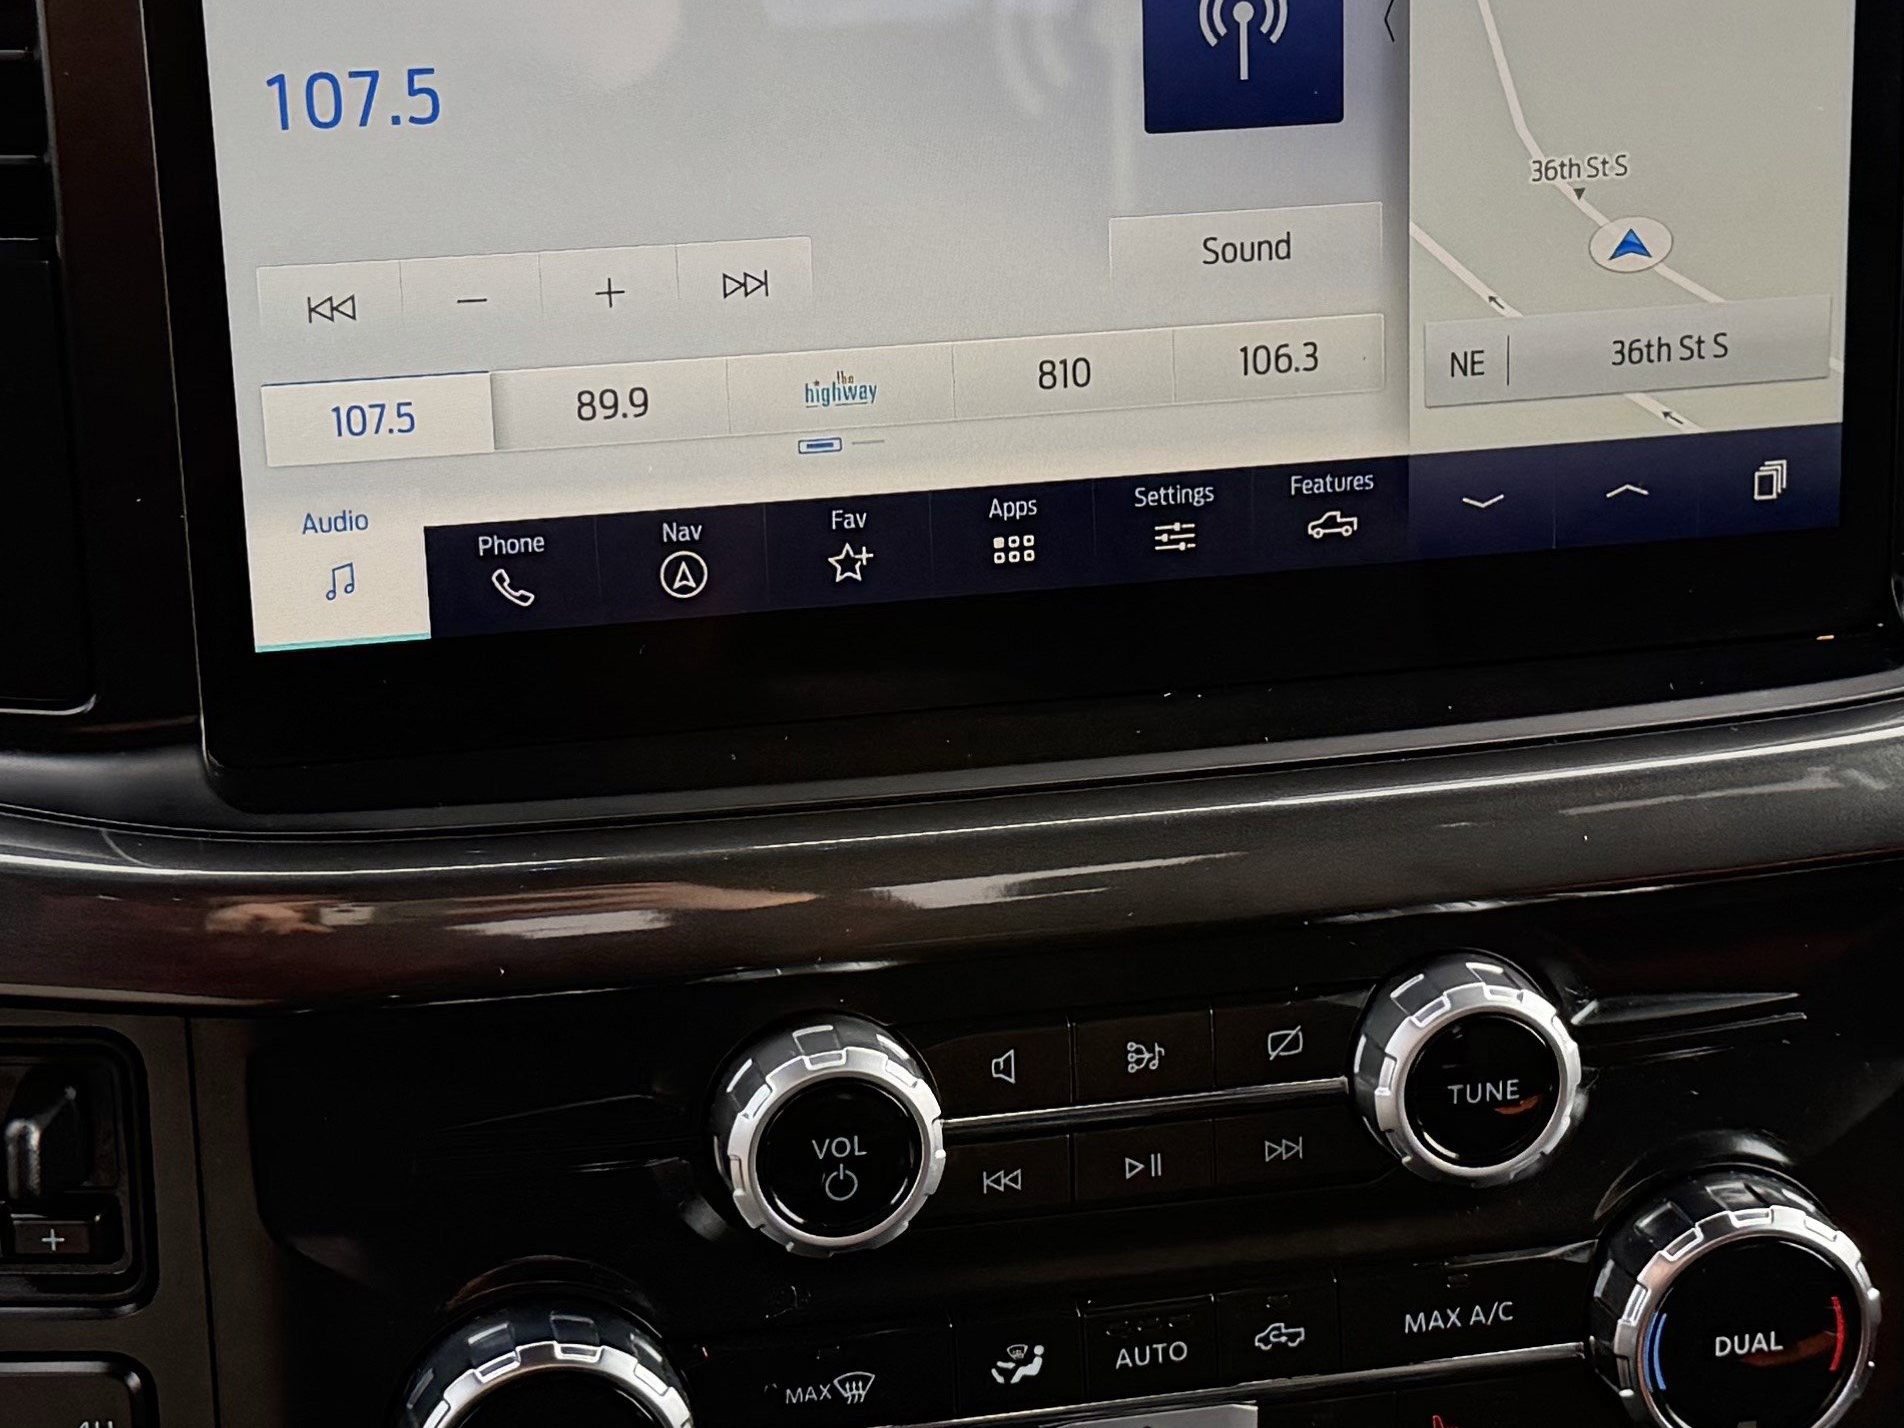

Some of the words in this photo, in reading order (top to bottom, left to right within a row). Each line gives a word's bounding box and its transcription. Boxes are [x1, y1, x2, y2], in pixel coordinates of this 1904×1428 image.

[265, 67, 442, 131] 107.5
[1531, 154, 1582, 183] 36th
[1585, 154, 1610, 179] St
[1613, 152, 1630, 177] S
[1201, 231, 1292, 266] Sound
[1238, 341, 1320, 377] 106.3
[1450, 349, 1486, 378] NE
[1611, 335, 1673, 368] 36th
[1676, 334, 1707, 364] St
[1711, 332, 1730, 360] S
[1036, 356, 1092, 390] 810
[575, 385, 650, 423] 89.9
[804, 380, 878, 408] highway
[330, 401, 416, 440] 107.5
[1134, 481, 1216, 509] Settings
[1290, 470, 1375, 496] Features
[301, 509, 370, 535] Audio
[830, 508, 868, 532] Fav
[988, 496, 1038, 521] Apps
[478, 531, 545, 557] Phone
[661, 521, 703, 544] Nav
[1447, 1078, 1521, 1105] TUNE
[811, 1136, 868, 1159] VOL
[1404, 1307, 1463, 1334] MAX
[1468, 1300, 1514, 1330] A/C
[1114, 1341, 1189, 1369] AUTO
[1714, 1331, 1784, 1358] DUAL
[784, 1384, 833, 1405] MAX
